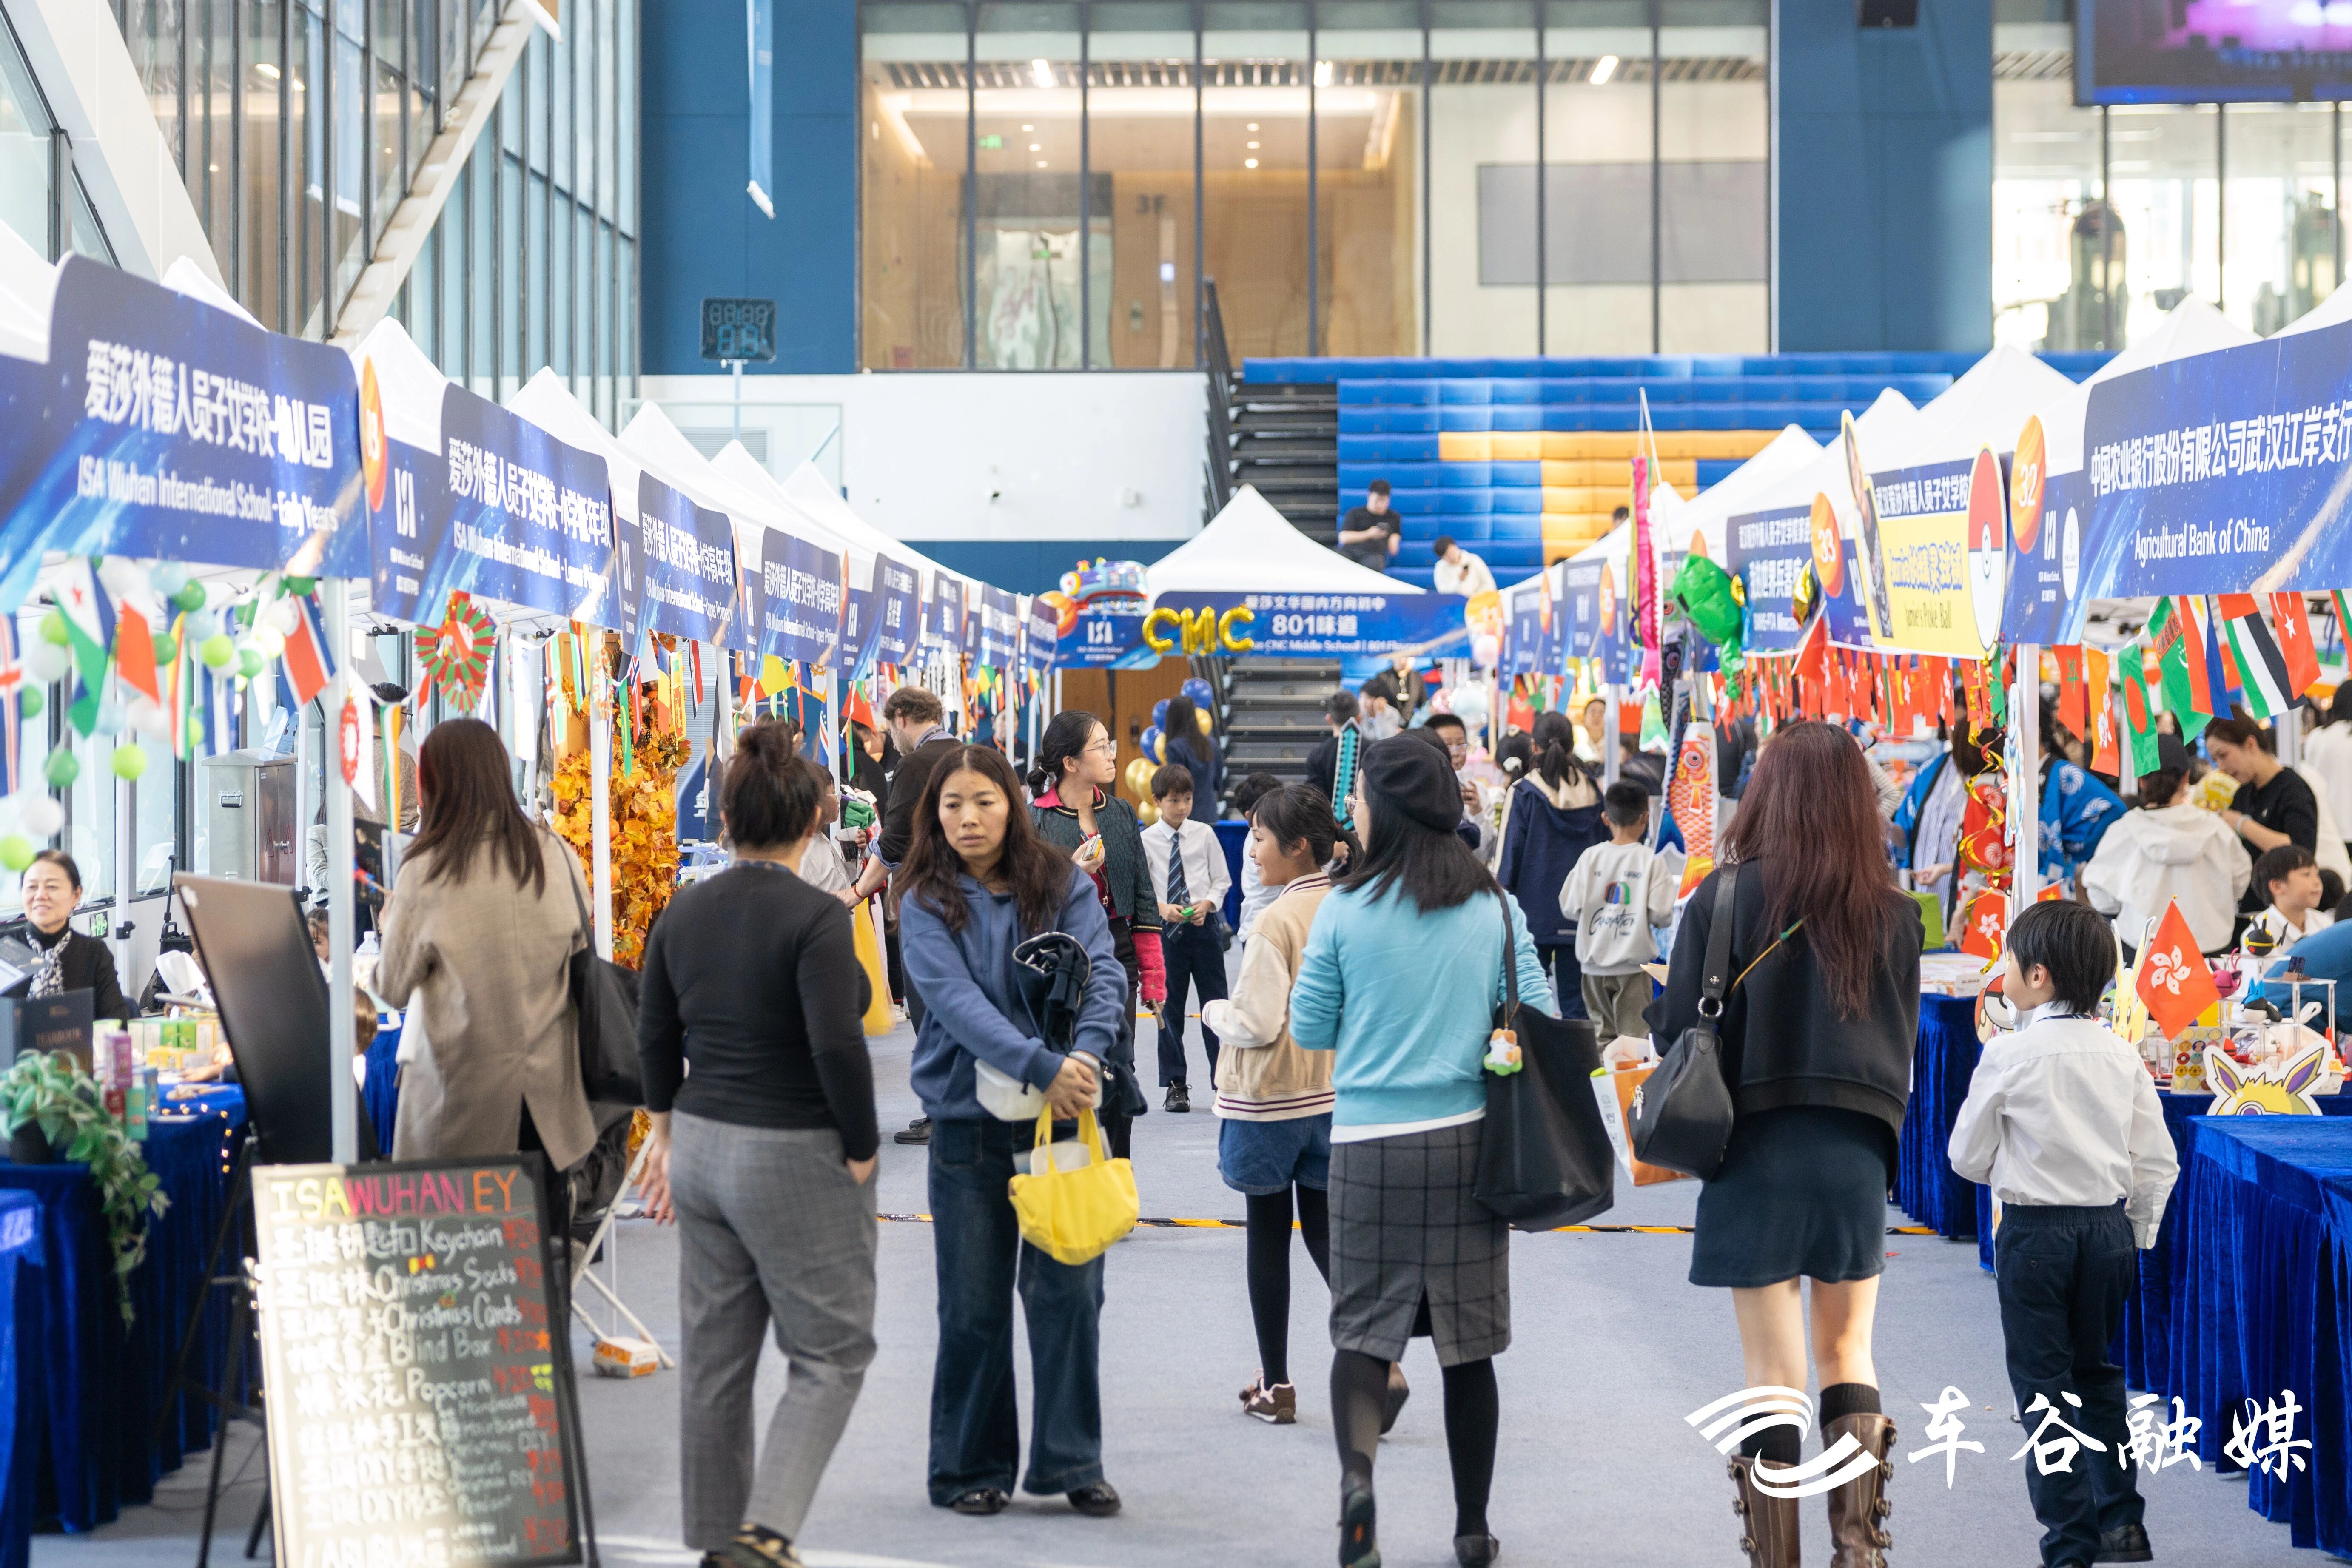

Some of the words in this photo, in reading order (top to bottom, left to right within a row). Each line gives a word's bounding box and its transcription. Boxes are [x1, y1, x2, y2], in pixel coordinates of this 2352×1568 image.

[2090, 399, 2352, 497] 中国农业银行股份有限公司武汉江岸支行
[77, 454, 105, 498] ISA
[107, 461, 157, 506] Wuhan
[158, 468, 236, 517] International
[237, 482, 273, 523] School
[1875, 473, 1971, 517] 武汉爱莎外籍人员子女学校
[2019, 463, 2037, 508] 32
[454, 520, 467, 549] ISA
[467, 525, 493, 559] Wuhan
[494, 534, 539, 572] International
[539, 548, 561, 579] School
[1818, 528, 1836, 563] 33
[2134, 523, 2187, 568] Agricultural
[2189, 521, 2217, 557] Bank
[2218, 518, 2233, 554] of
[2234, 516, 2270, 554] China
[652, 577, 664, 602] Wuhan
[665, 583, 692, 610] International
[705, 597, 716, 622] Upper
[715, 600, 733, 627] Primary
[1272, 614, 1358, 636] 801味道
[1940, 600, 1952, 629] Ball
[1142, 606, 1255, 656] CMC
[345, 1170, 464, 1217] WUHAN
[472, 1170, 517, 1212] EY
[420, 1220, 503, 1266] Keychain
[375, 1264, 464, 1302] Christmas
[464, 1256, 519, 1292] Socks
[383, 1301, 473, 1337] Christmas
[473, 1291, 523, 1331] Cards
[390, 1330, 449, 1368] Blind
[452, 1326, 492, 1360] Box
[407, 1367, 491, 1411] Popcorn
